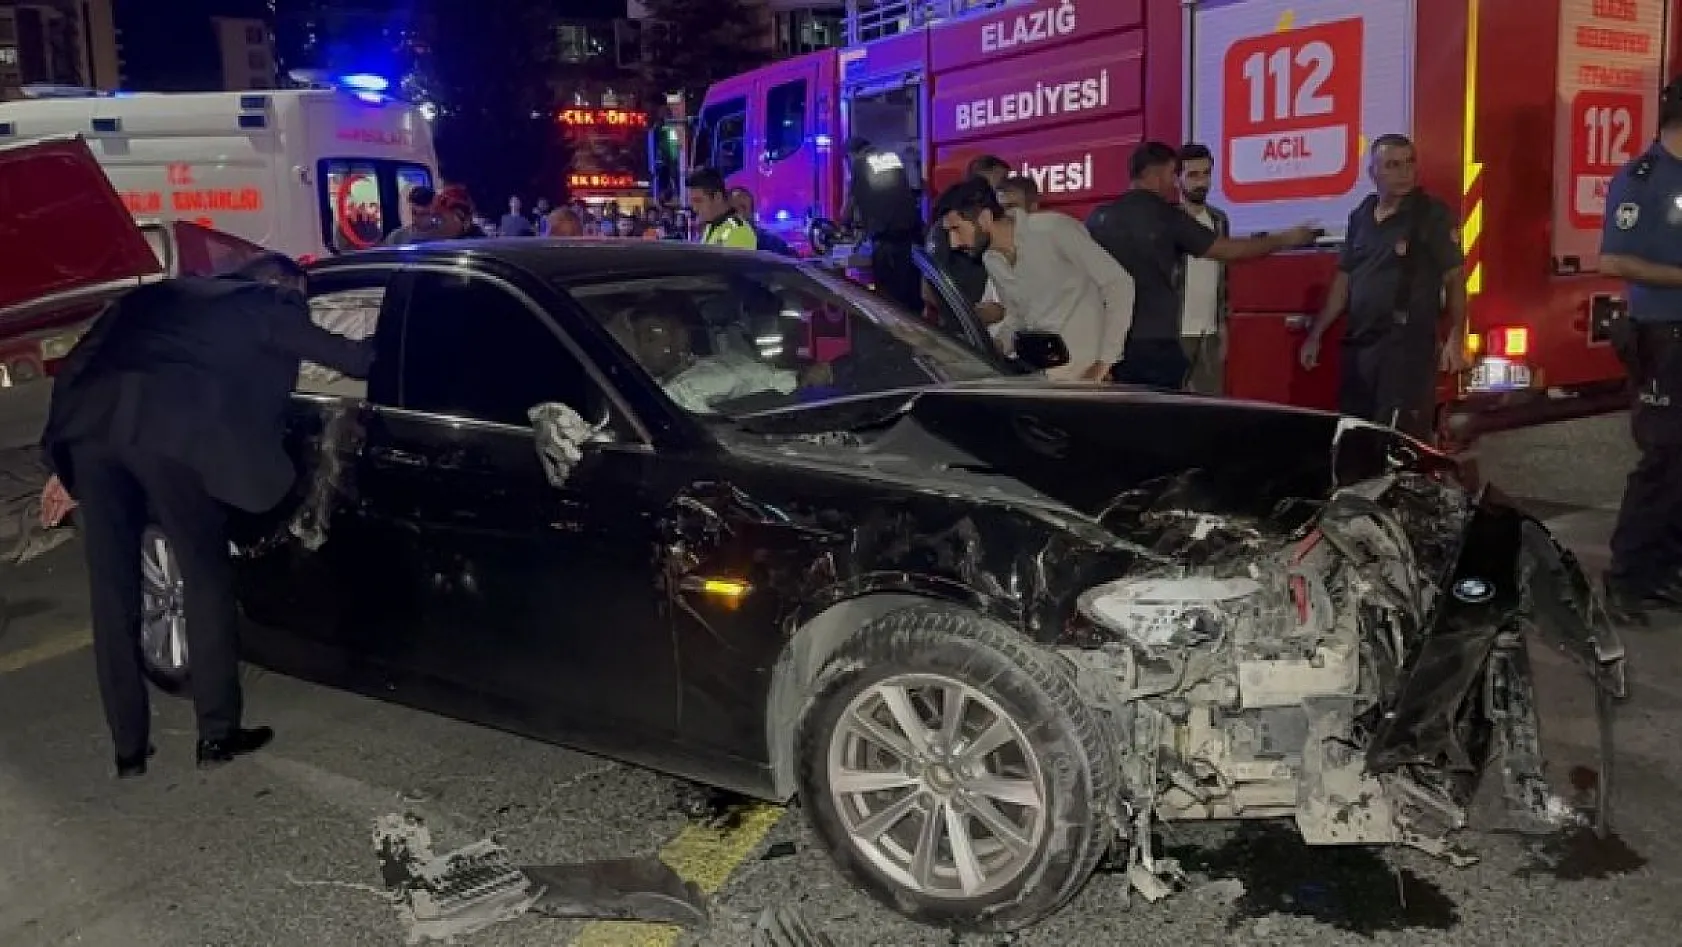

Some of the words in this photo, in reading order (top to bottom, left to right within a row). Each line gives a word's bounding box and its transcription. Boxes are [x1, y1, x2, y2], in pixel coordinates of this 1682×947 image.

[981, 0, 1075, 53] ELAZIĞ
[955, 68, 1108, 131] BELEDİYESİ
[1242, 40, 1335, 123] 112
[1261, 136, 1312, 163] ACİL
[1584, 106, 1632, 166] 112
